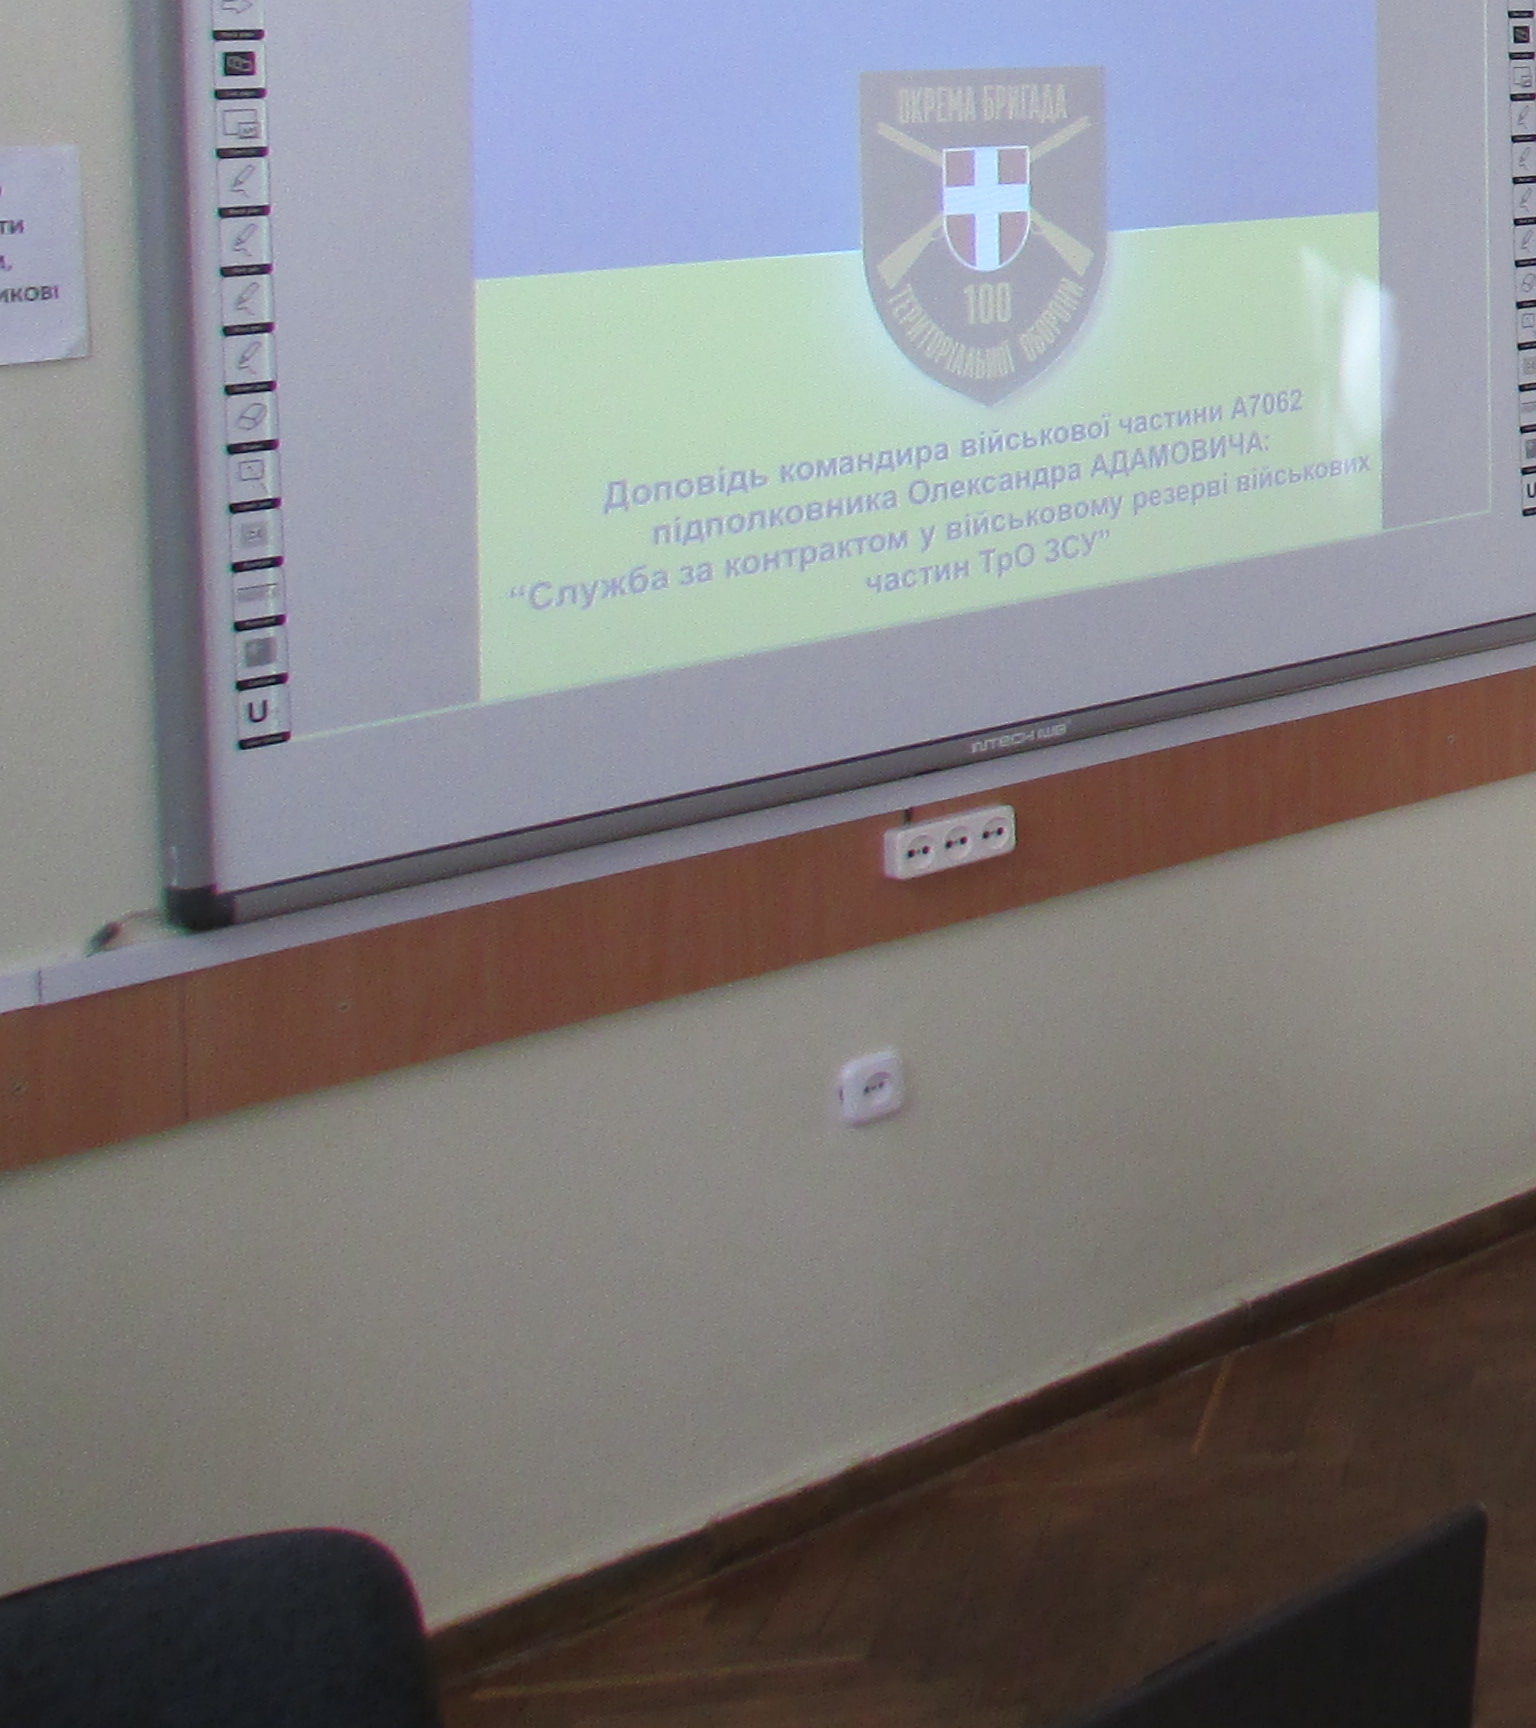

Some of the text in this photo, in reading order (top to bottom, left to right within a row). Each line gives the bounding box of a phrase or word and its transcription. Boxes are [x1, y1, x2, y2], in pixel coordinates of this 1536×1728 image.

[899, 82, 1069, 124] ОКРЕМА БРИГАДА
[0, 219, 25, 235] ТИ
[0, 285, 60, 304] ИКОВІ
[962, 281, 1013, 325] 100
[603, 388, 1304, 514] Доповідь командира військової частини А7062
[652, 431, 1271, 546] підполковника Олександра АДАМОВИЧА:
[679, 561, 714, 586] за
[725, 528, 909, 578] контрактом
[919, 524, 937, 552] у
[946, 494, 1124, 541] військовому
[1131, 472, 1229, 515] резерві
[1235, 454, 1372, 493] військових
[865, 558, 970, 594] частин
[979, 541, 1036, 577] ТрО
